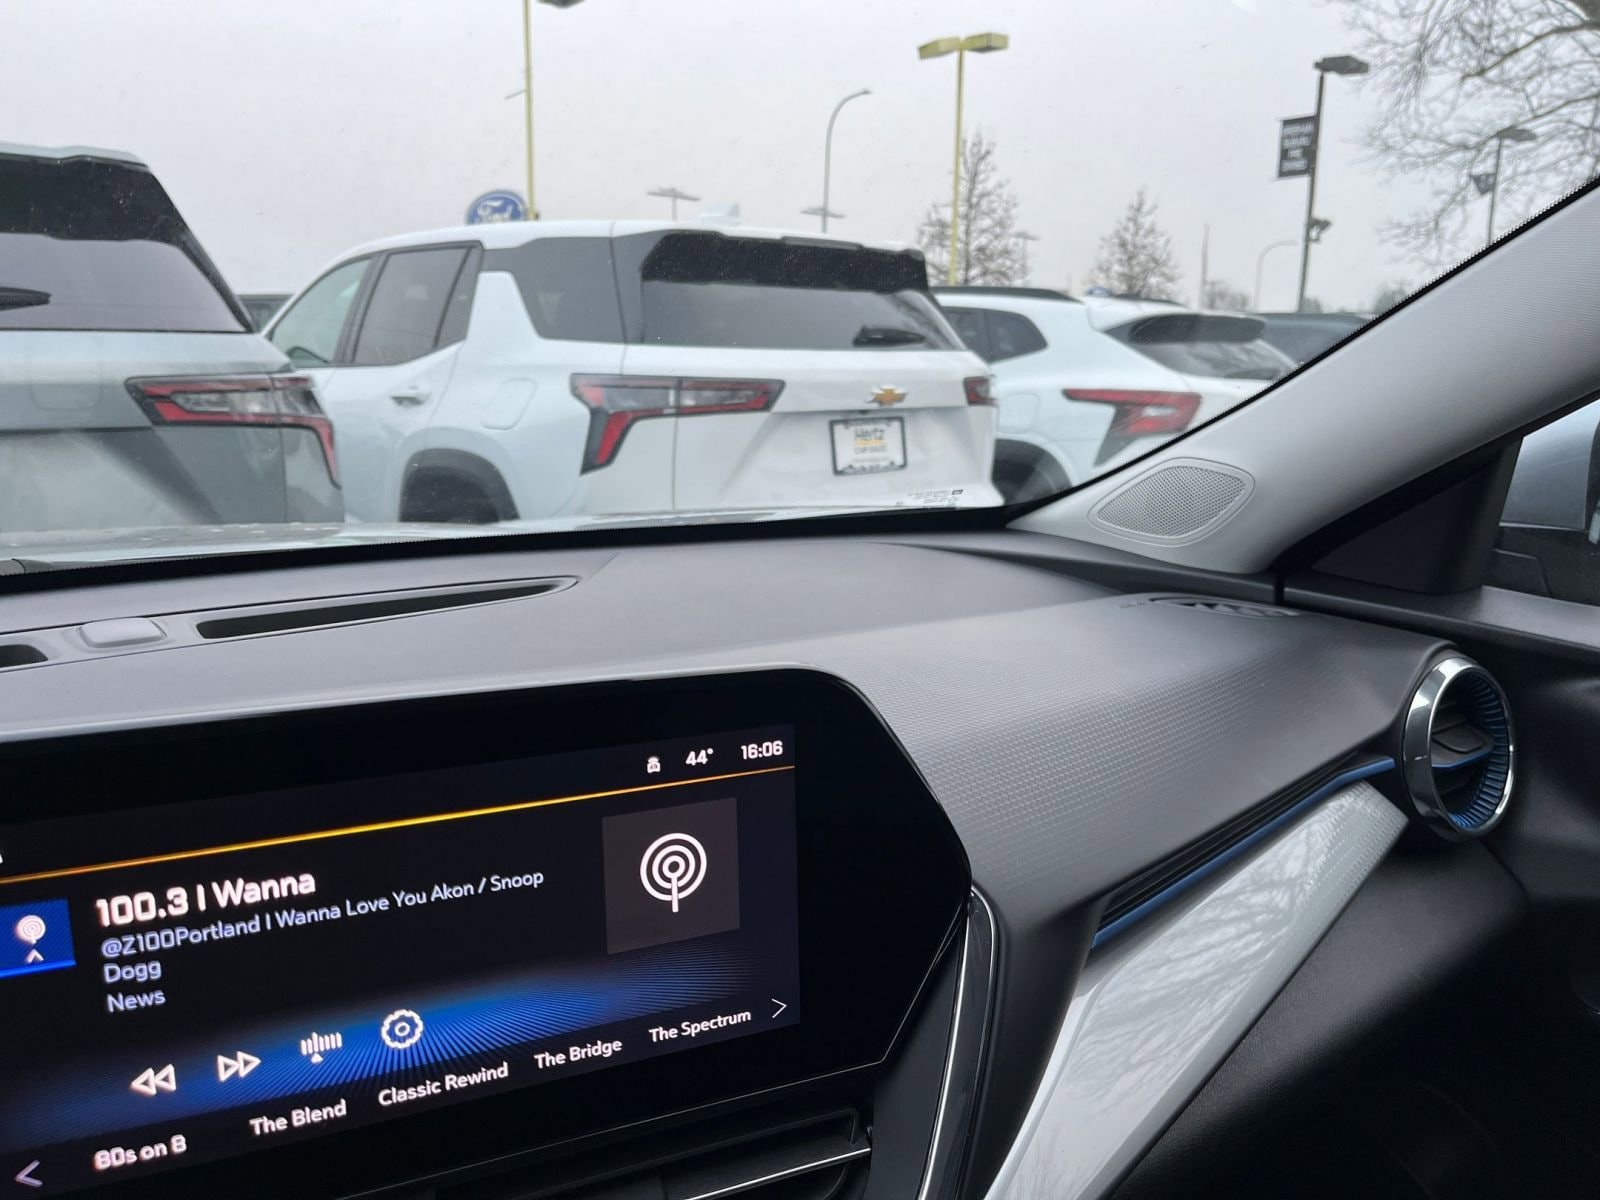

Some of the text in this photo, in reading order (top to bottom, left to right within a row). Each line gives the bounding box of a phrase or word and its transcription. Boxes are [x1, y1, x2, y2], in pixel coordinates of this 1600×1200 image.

[740, 740, 783, 760] 16:06
[95, 886, 189, 927] 100.3
[211, 873, 316, 908] Wanna
[101, 914, 261, 957] @Z100Portland
[275, 906, 341, 928] Wanna
[345, 898, 389, 916] Love
[392, 890, 427, 908] You
[430, 883, 474, 902] Akon
[478, 877, 487, 894] /
[490, 872, 544, 892] Snoop
[103, 961, 162, 983] Dogg
[107, 991, 166, 1013] News
[648, 1011, 751, 1043] The Spectrum
[533, 1039, 623, 1069] The Bridge
[378, 1062, 509, 1106] Classic Rewind
[249, 1099, 347, 1135] The Blend
[94, 1134, 187, 1170] 80s on 8
